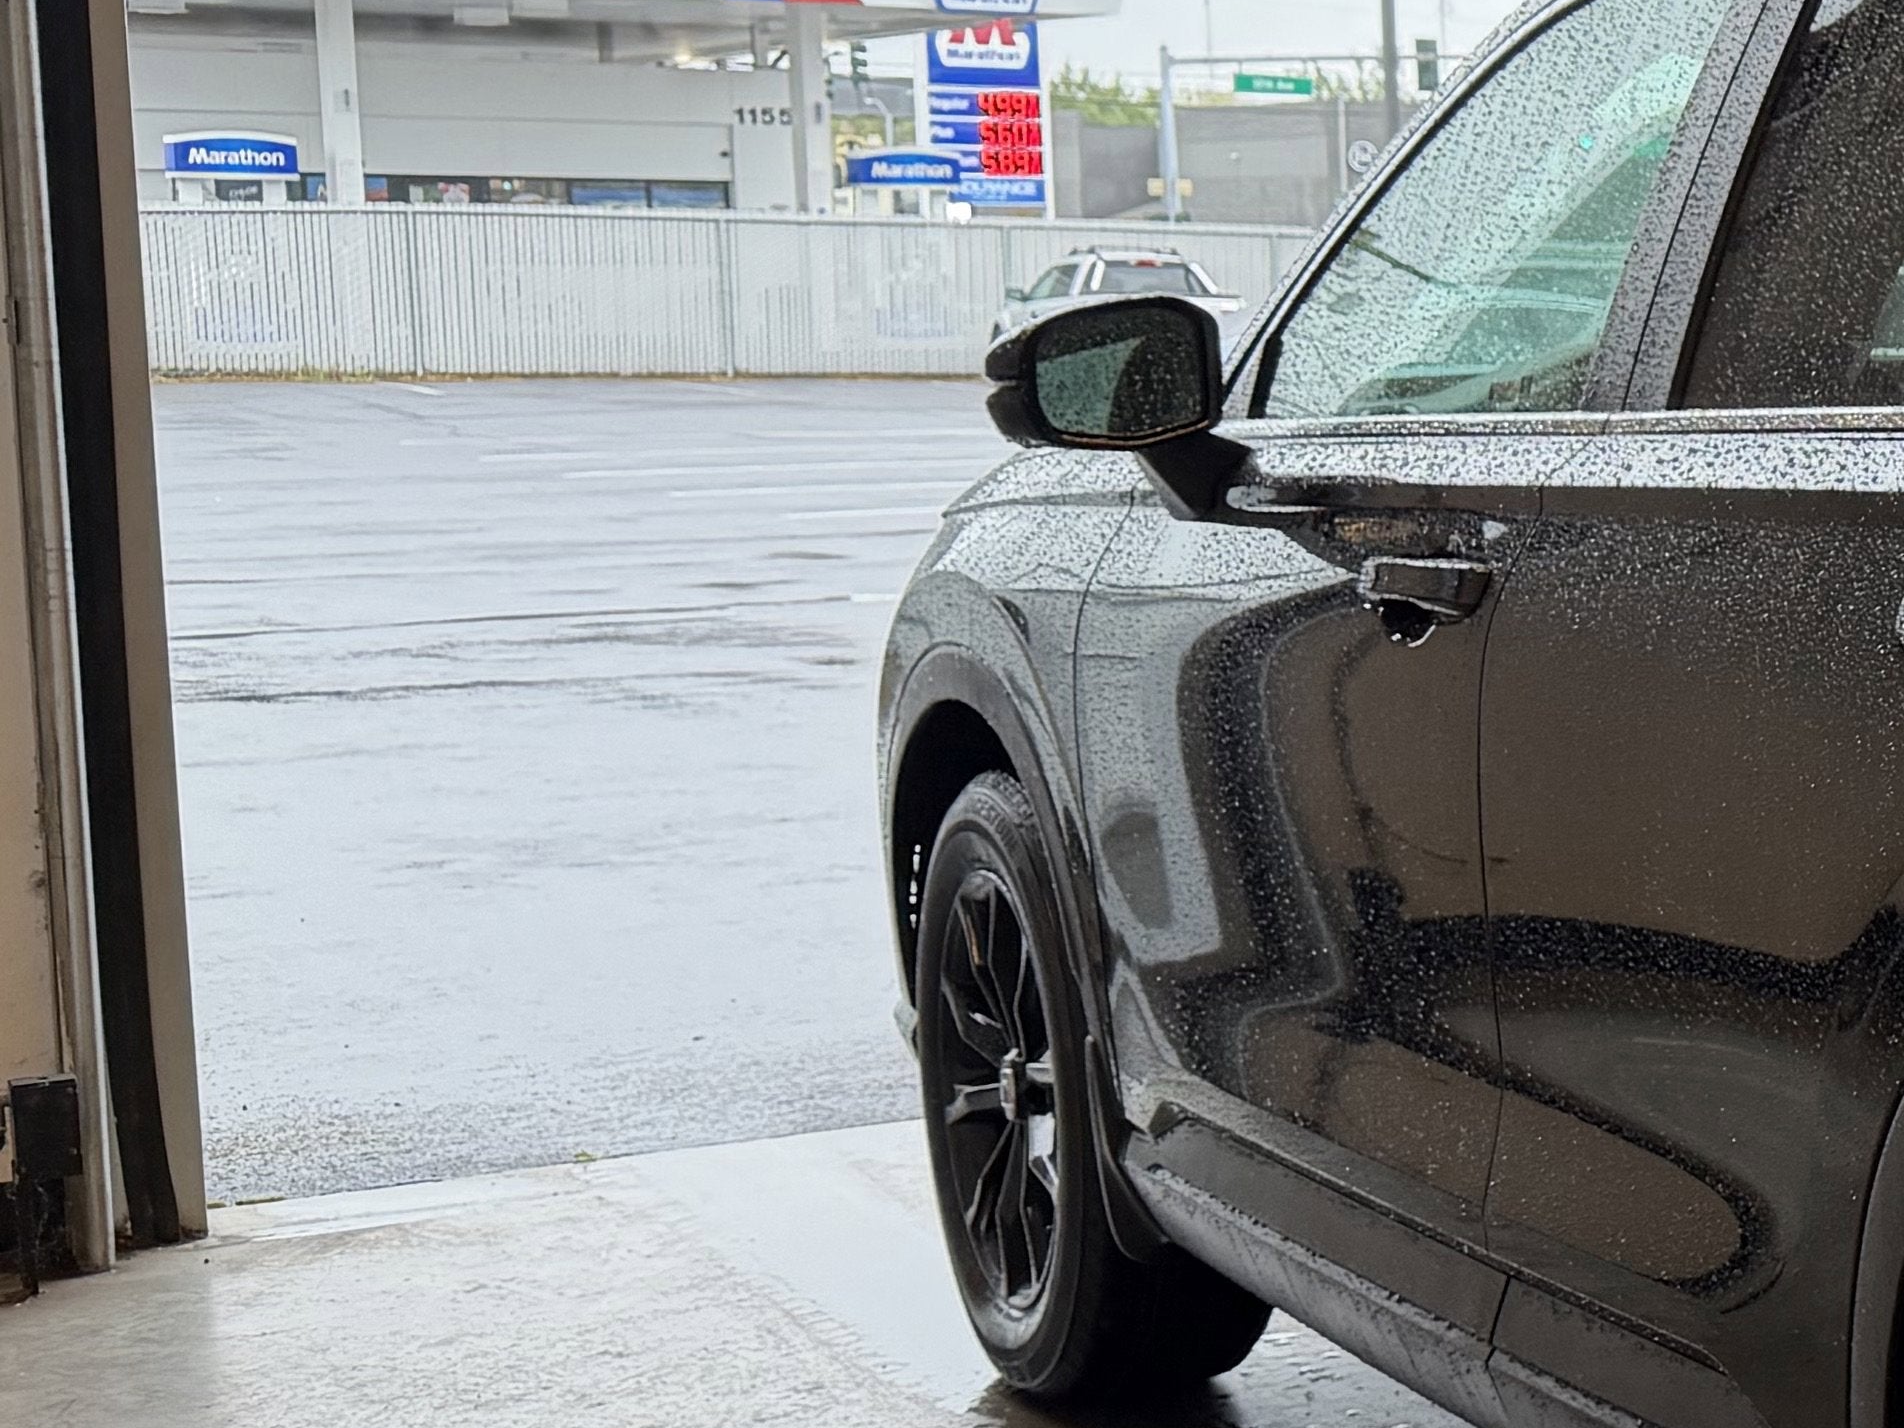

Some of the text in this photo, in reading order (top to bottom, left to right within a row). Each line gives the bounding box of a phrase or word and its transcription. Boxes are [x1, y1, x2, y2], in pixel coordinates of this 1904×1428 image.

[733, 108, 793, 125] 1155
[188, 147, 285, 166] Marathon
[871, 161, 953, 179] Marathon
